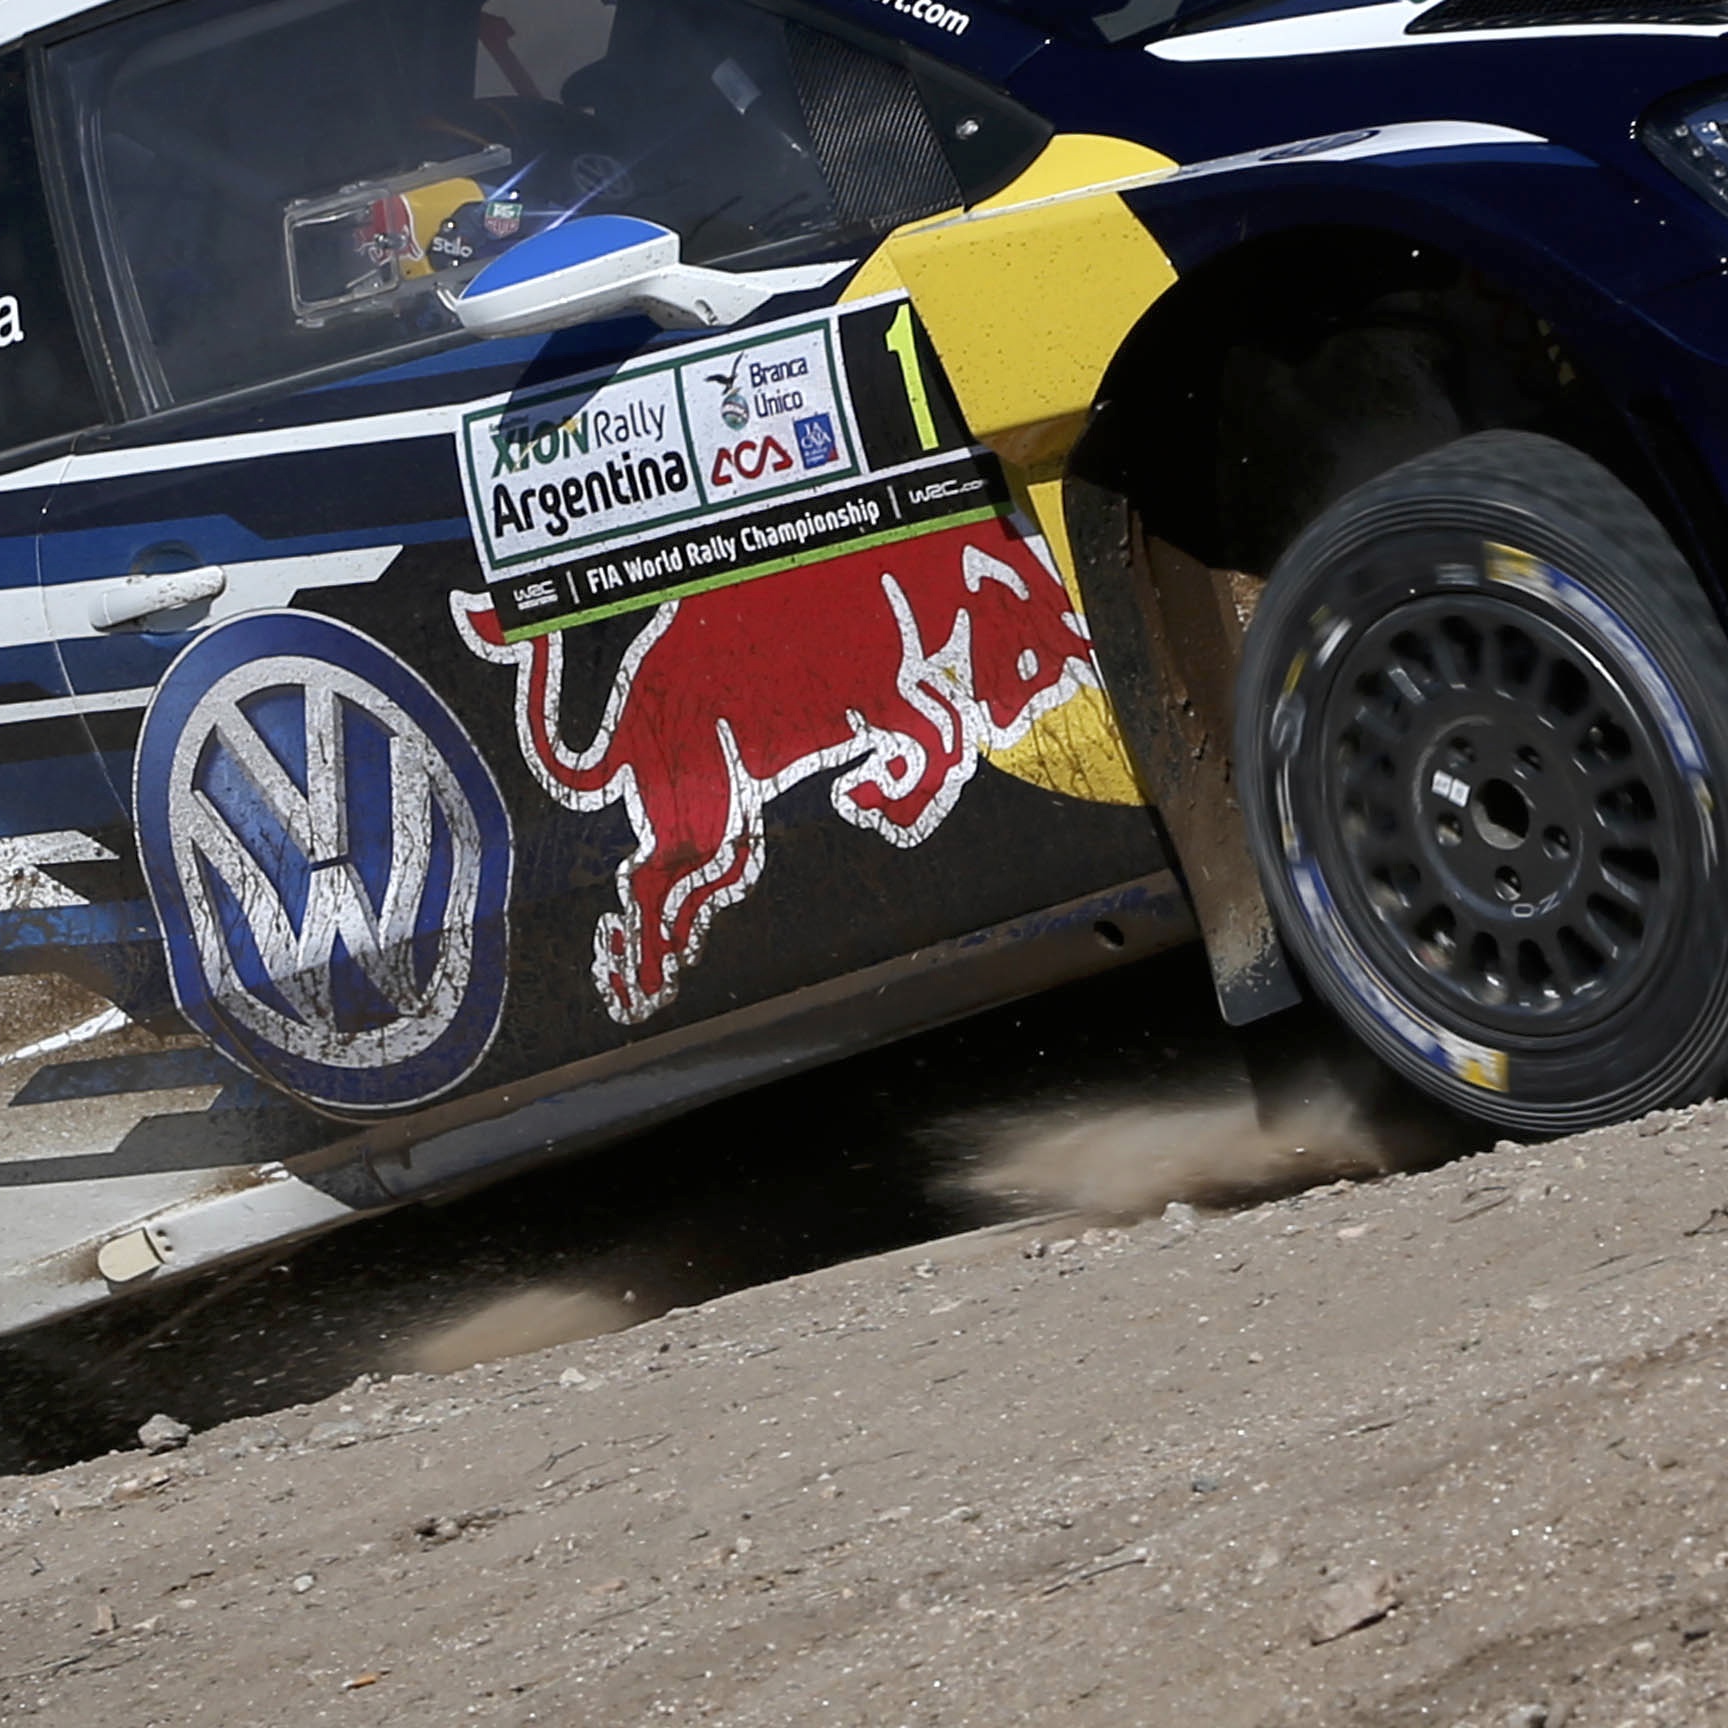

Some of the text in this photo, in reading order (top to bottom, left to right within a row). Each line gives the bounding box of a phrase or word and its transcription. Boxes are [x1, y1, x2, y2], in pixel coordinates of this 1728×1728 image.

[749, 356, 809, 388] Branca
[885, 303, 939, 452] 1
[593, 400, 664, 448] Rally
[493, 451, 688, 538] Argentina
[586, 565, 623, 594] FIA
[623, 546, 683, 584] World
[686, 535, 735, 568] Rally
[740, 498, 880, 553] Championship
